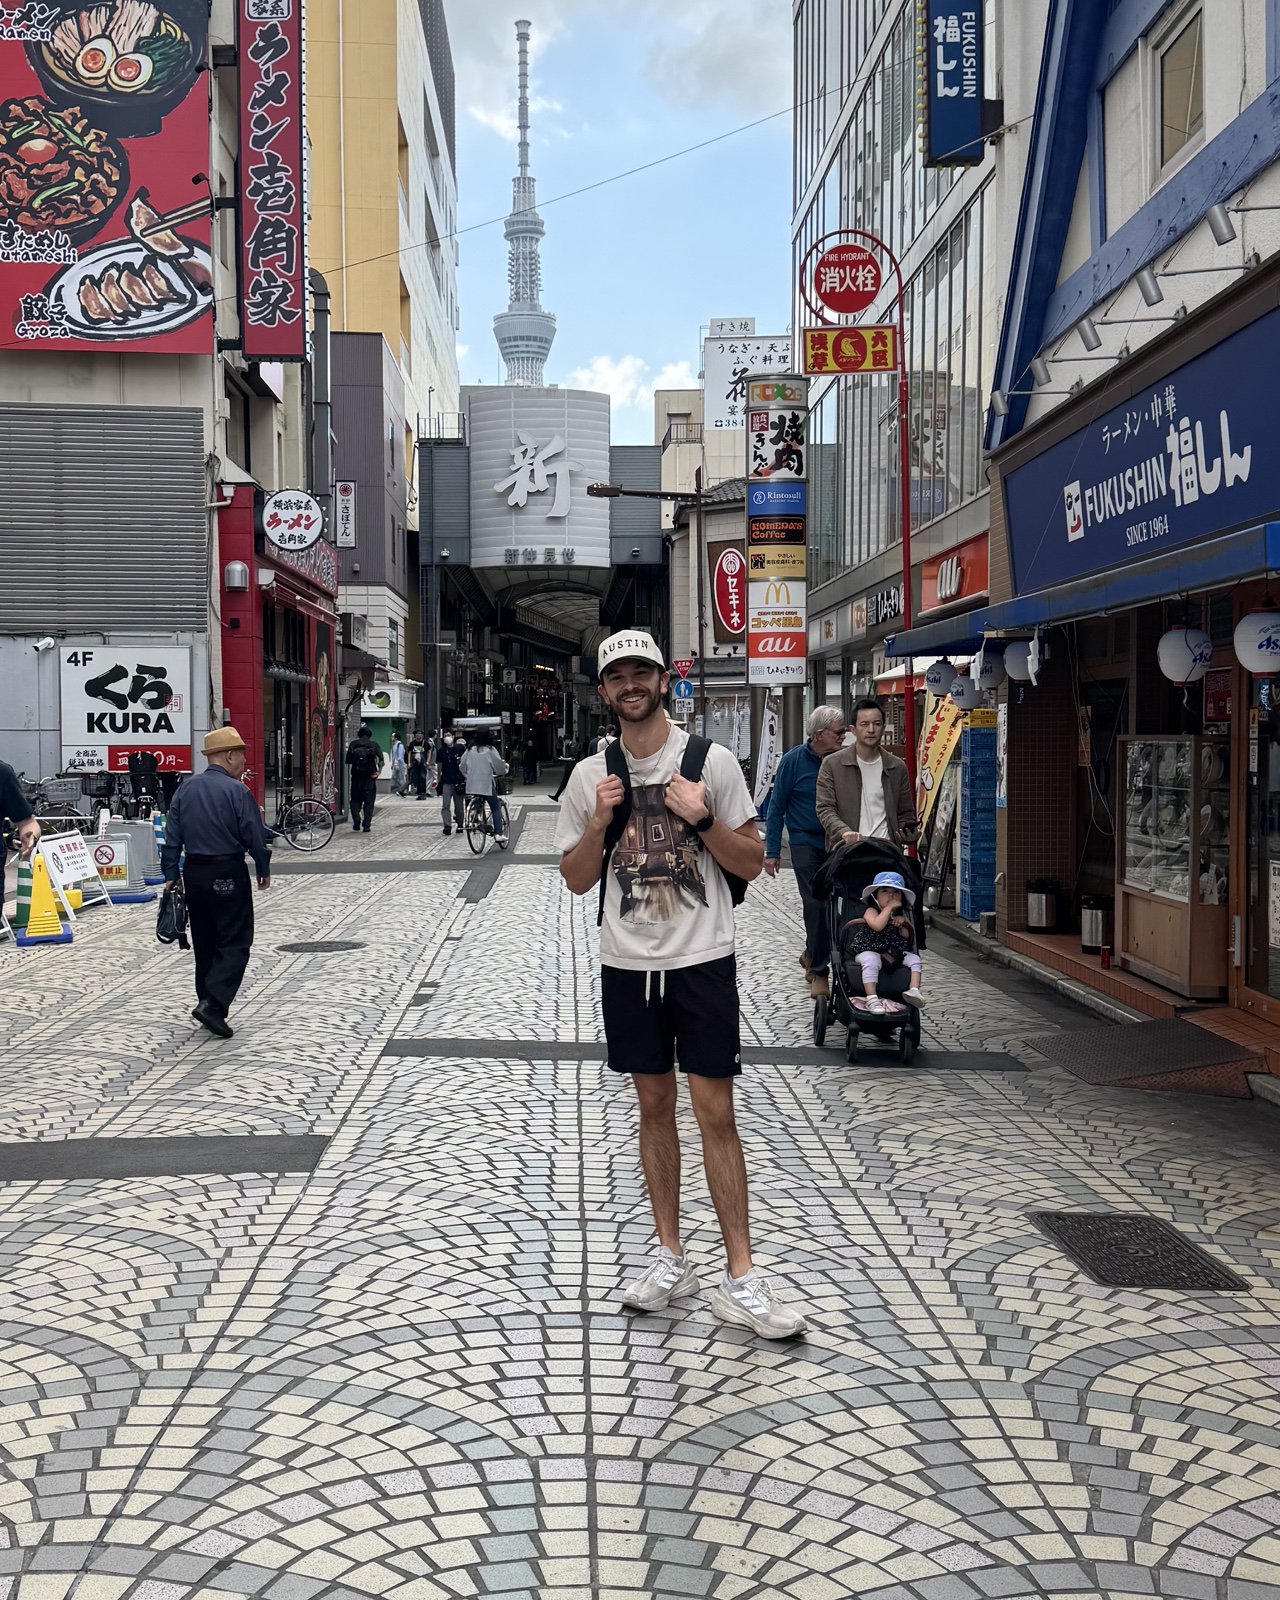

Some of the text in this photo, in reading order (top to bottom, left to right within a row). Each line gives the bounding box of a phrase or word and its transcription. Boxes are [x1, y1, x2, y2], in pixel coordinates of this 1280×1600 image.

[0, 2, 61, 29] ーメン
[933, 15, 961, 98] 福しん
[962, 11, 977, 98] FUKUSHIN
[0, 248, 78, 264] utameshi
[824, 252, 870, 262] FIRE HYDRANT
[820, 264, 877, 294] 消火栓
[19, 293, 68, 323] 餃子
[15, 321, 71, 340] Gyoza
[716, 321, 750, 332] すき焼
[733, 355, 791, 366] ふぐ料理
[1102, 384, 1177, 455] ラーメン・中華
[770, 411, 805, 477] 焼肉
[752, 433, 769, 477] きんぐ
[1166, 409, 1252, 508] 福しん
[493, 429, 586, 519] 新
[767, 491, 802, 500] Rintosull
[1084, 453, 1168, 528] FUKUSHIN
[273, 499, 313, 511] 横浜家系
[265, 511, 319, 531] ラーメン
[341, 504, 351, 537] さぼてん
[1126, 514, 1170, 547] SINCE 1964
[278, 533, 308, 545] 壱角家
[752, 530, 786, 539] Coffee
[504, 547, 576, 564] 新仲見世
[726, 576, 741, 628] セキネ
[751, 616, 803, 628] コッペ田島
[603, 639, 648, 659] AUSTIN
[758, 637, 797, 653] au
[66, 651, 94, 667] 4F
[84, 663, 174, 711] くら
[86, 712, 175, 734] KURA
[68, 758, 104, 767] 税込価格
[75, 749, 98, 758] 全商品
